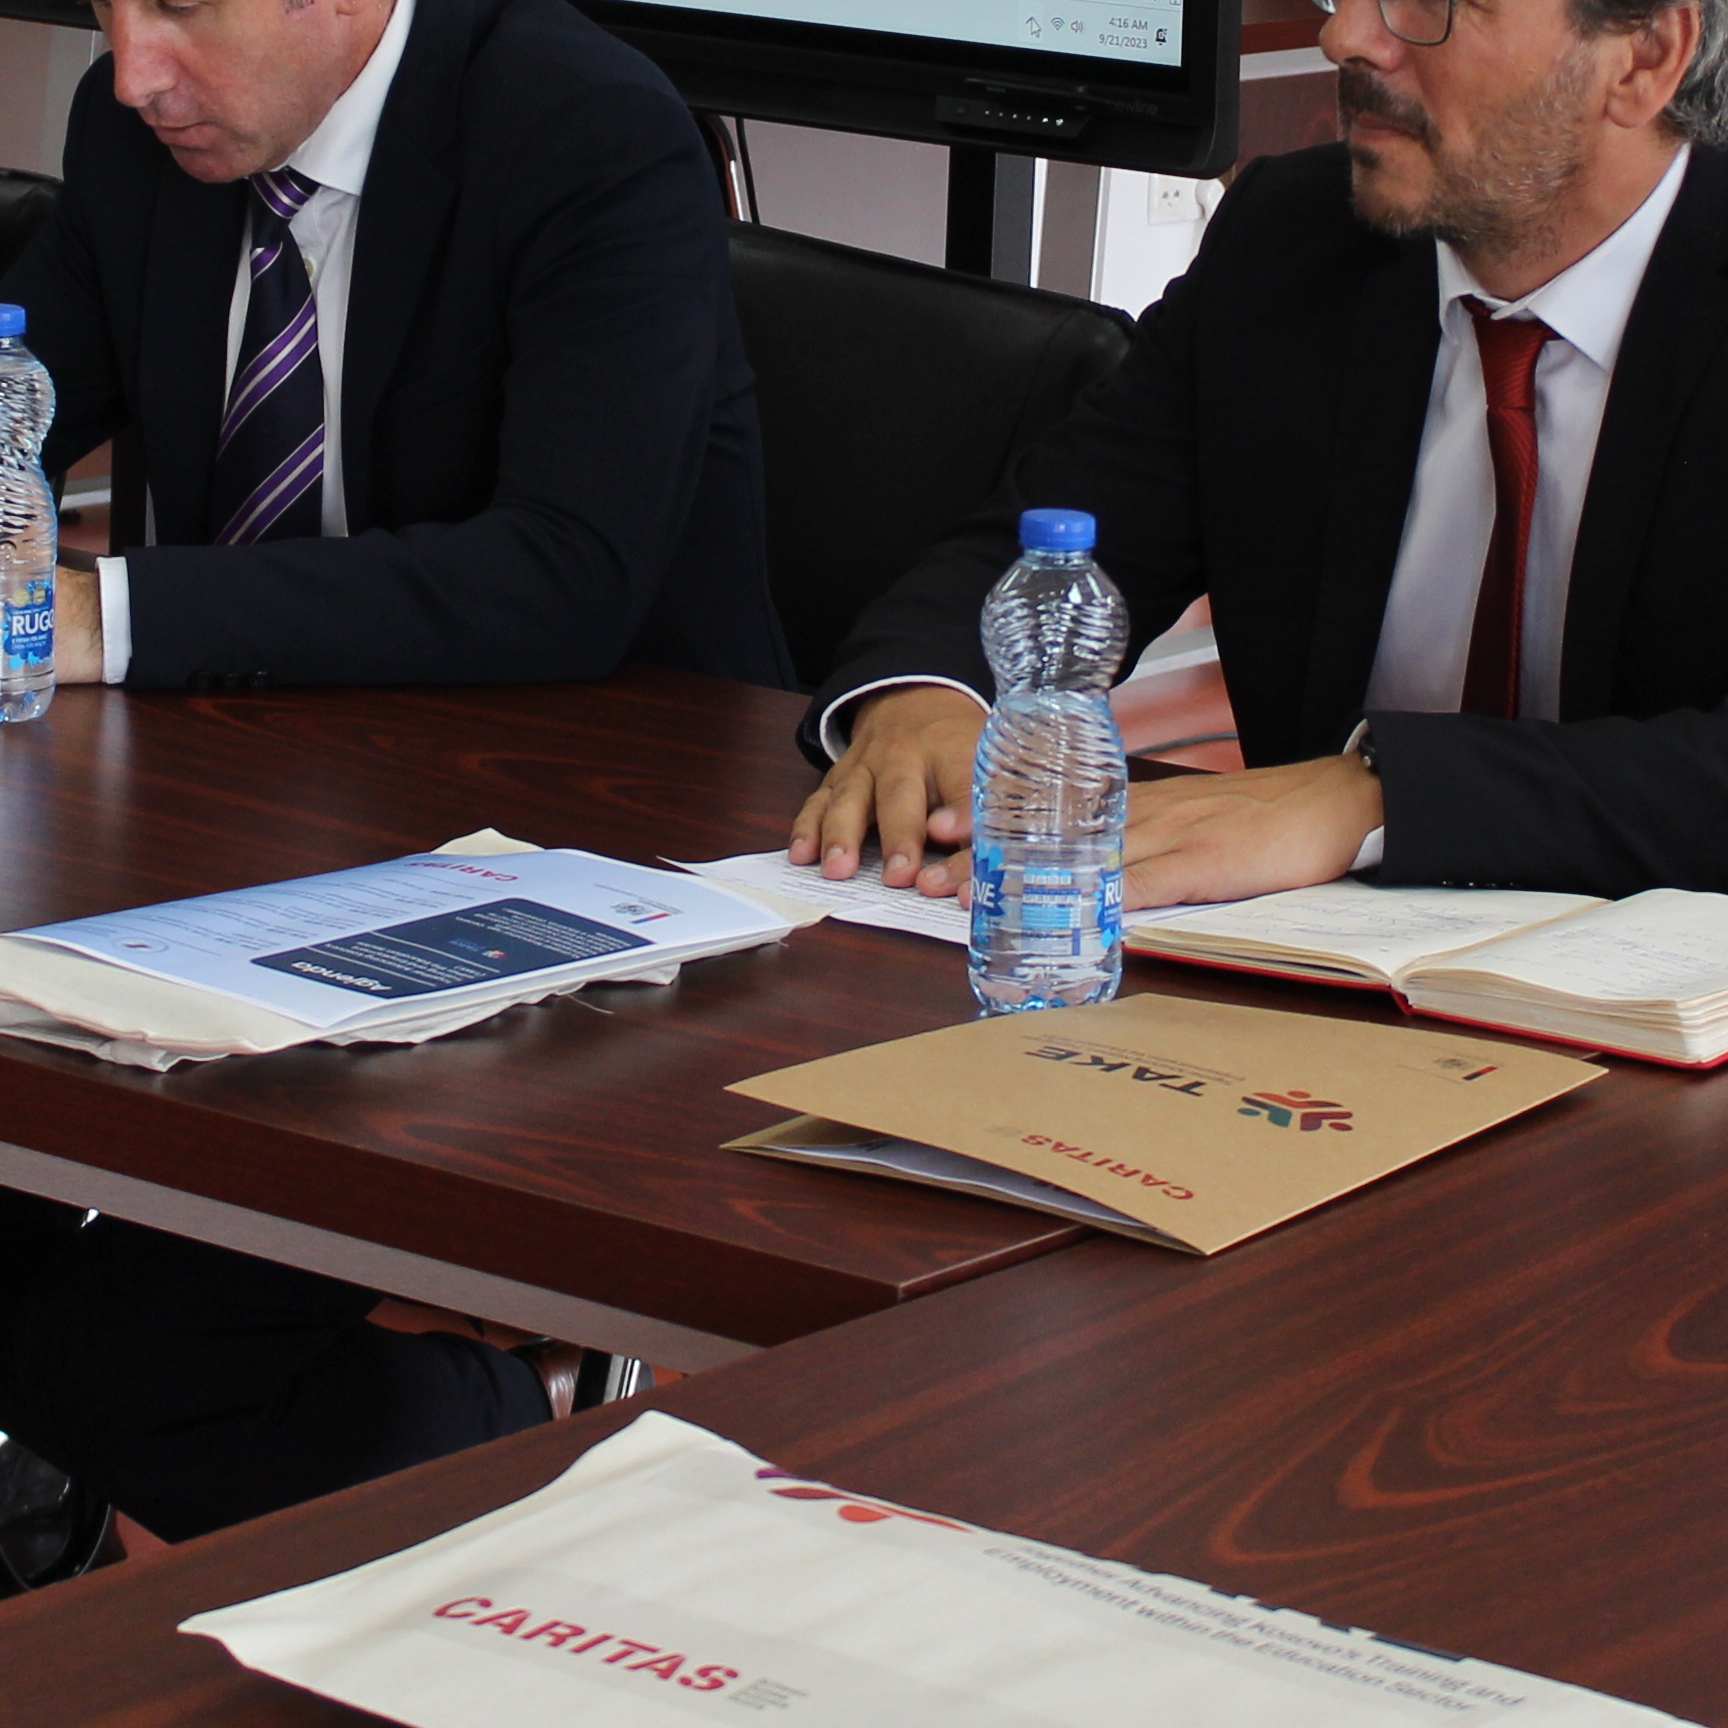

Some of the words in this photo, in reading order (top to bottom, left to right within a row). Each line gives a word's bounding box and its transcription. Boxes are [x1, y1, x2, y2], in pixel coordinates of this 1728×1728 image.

[1098, 33, 1148, 49] 9/21/2023
[1108, 17, 1128, 29] 4:16
[1130, 19, 1148, 31] AM
[291, 961, 392, 991] Agjenda
[1023, 1045, 1207, 1097] TAKE
[1021, 1134, 1195, 1201] CARITAS
[432, 1595, 740, 1692] CARITAS
[982, 1546, 1141, 1612] Employment
[1135, 1605, 1213, 1635] within
[1209, 1628, 1254, 1647] the
[1253, 1642, 1386, 1687] Education
[1384, 1680, 1479, 1712] Sector
[1119, 1577, 1251, 1628] Advancing
[1366, 1654, 1473, 1692] Training
[1465, 1684, 1527, 1706] and
